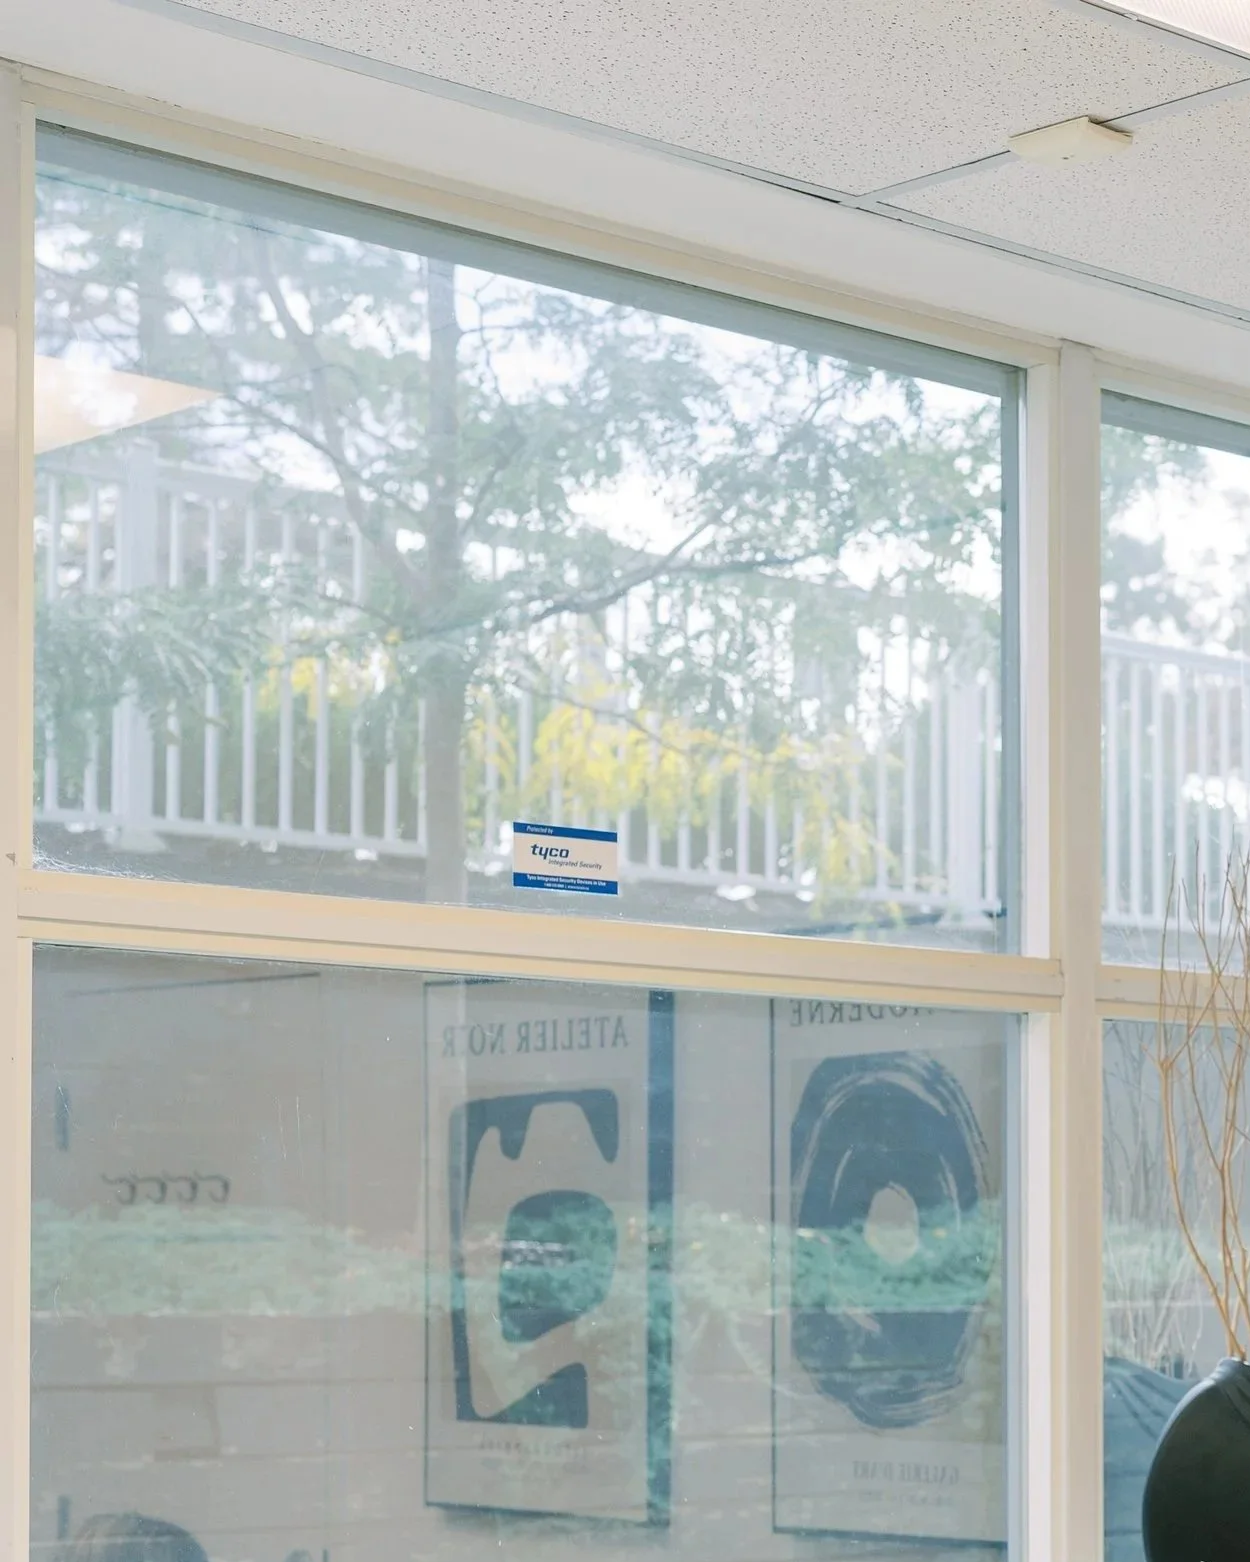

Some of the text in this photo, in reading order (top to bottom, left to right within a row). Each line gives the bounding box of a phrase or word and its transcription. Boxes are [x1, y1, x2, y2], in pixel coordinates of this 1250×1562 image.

[531, 844, 569, 859] tyco
[548, 859, 602, 869] Integrated Security
